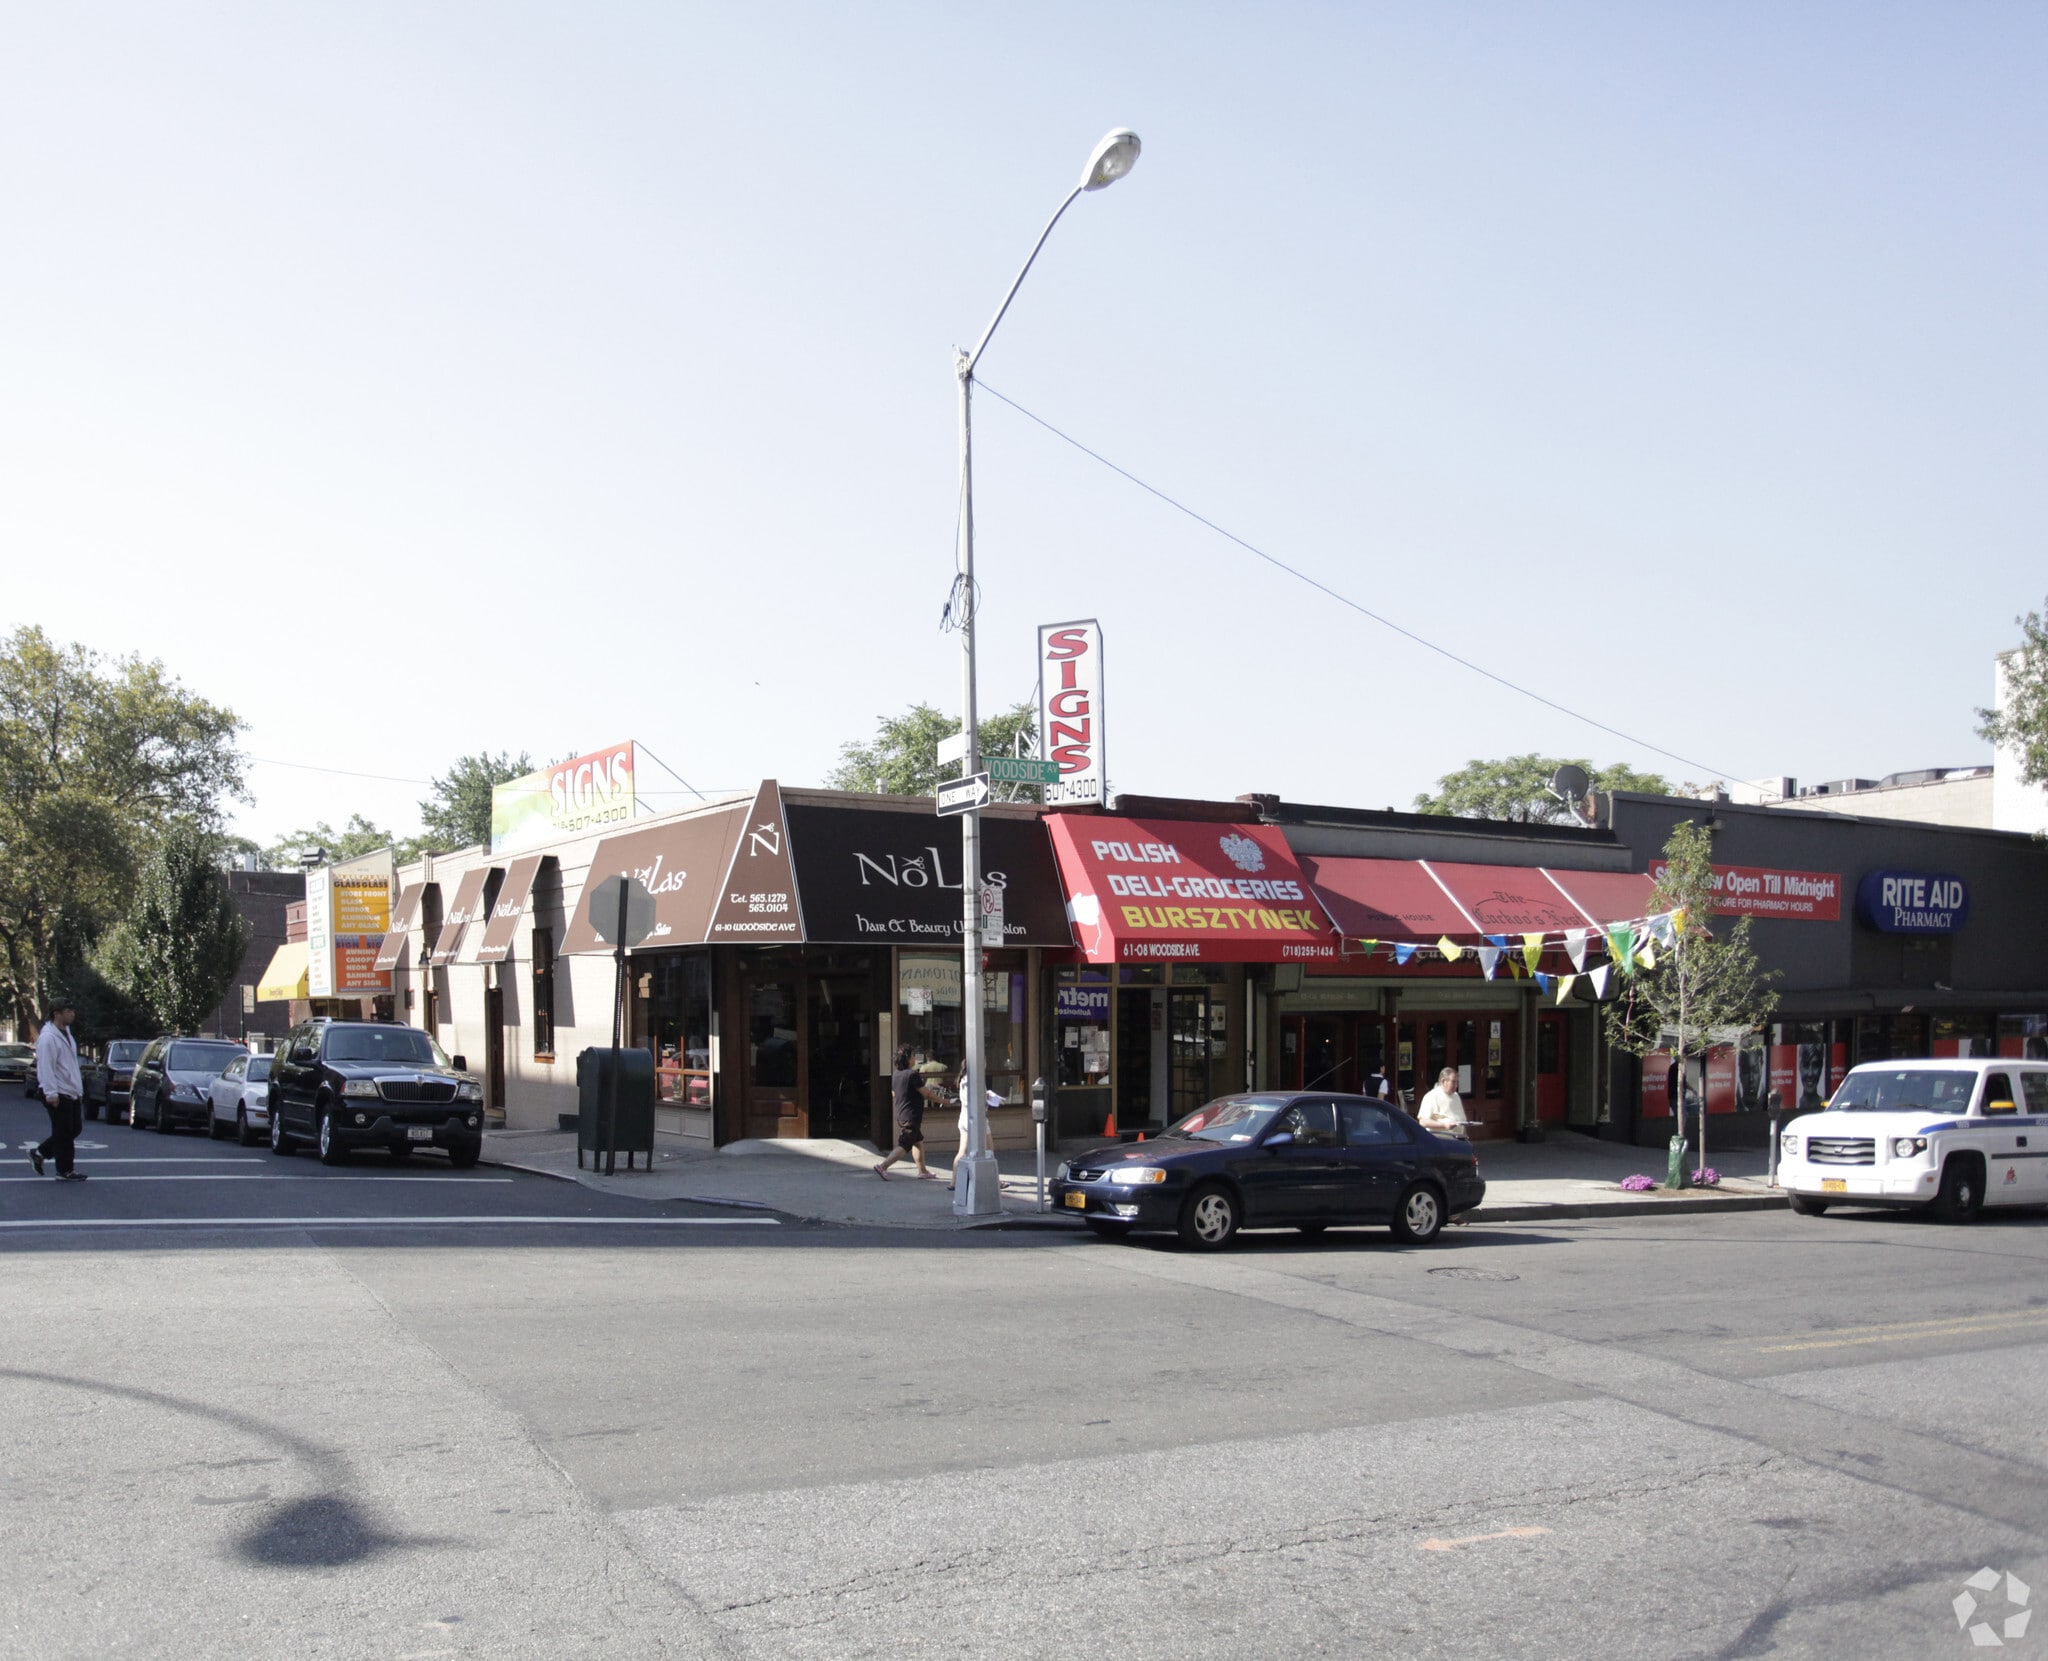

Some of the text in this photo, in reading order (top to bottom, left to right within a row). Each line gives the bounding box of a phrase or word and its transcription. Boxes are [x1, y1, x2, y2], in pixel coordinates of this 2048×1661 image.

[1046, 628, 1092, 775] SIGNS
[982, 759, 1058, 781] WOODSIDE AV
[550, 751, 630, 818] SIGNS
[940, 785, 980, 805] ONE WAY
[1091, 840, 1181, 864] POLISH
[1107, 874, 1304, 901] DELI-GROCERIES
[1726, 871, 1760, 895] Open
[1763, 874, 1781, 892] Till
[1784, 876, 1835, 901] Midnight
[1882, 878, 1963, 909] RITE AID
[1738, 899, 1751, 908] FOR
[1753, 900, 1789, 911] PHARMACY
[1791, 902, 1813, 912] HOURS
[1003, 923, 1027, 934] alon
[1121, 906, 1320, 931] BURSZTYNEK
